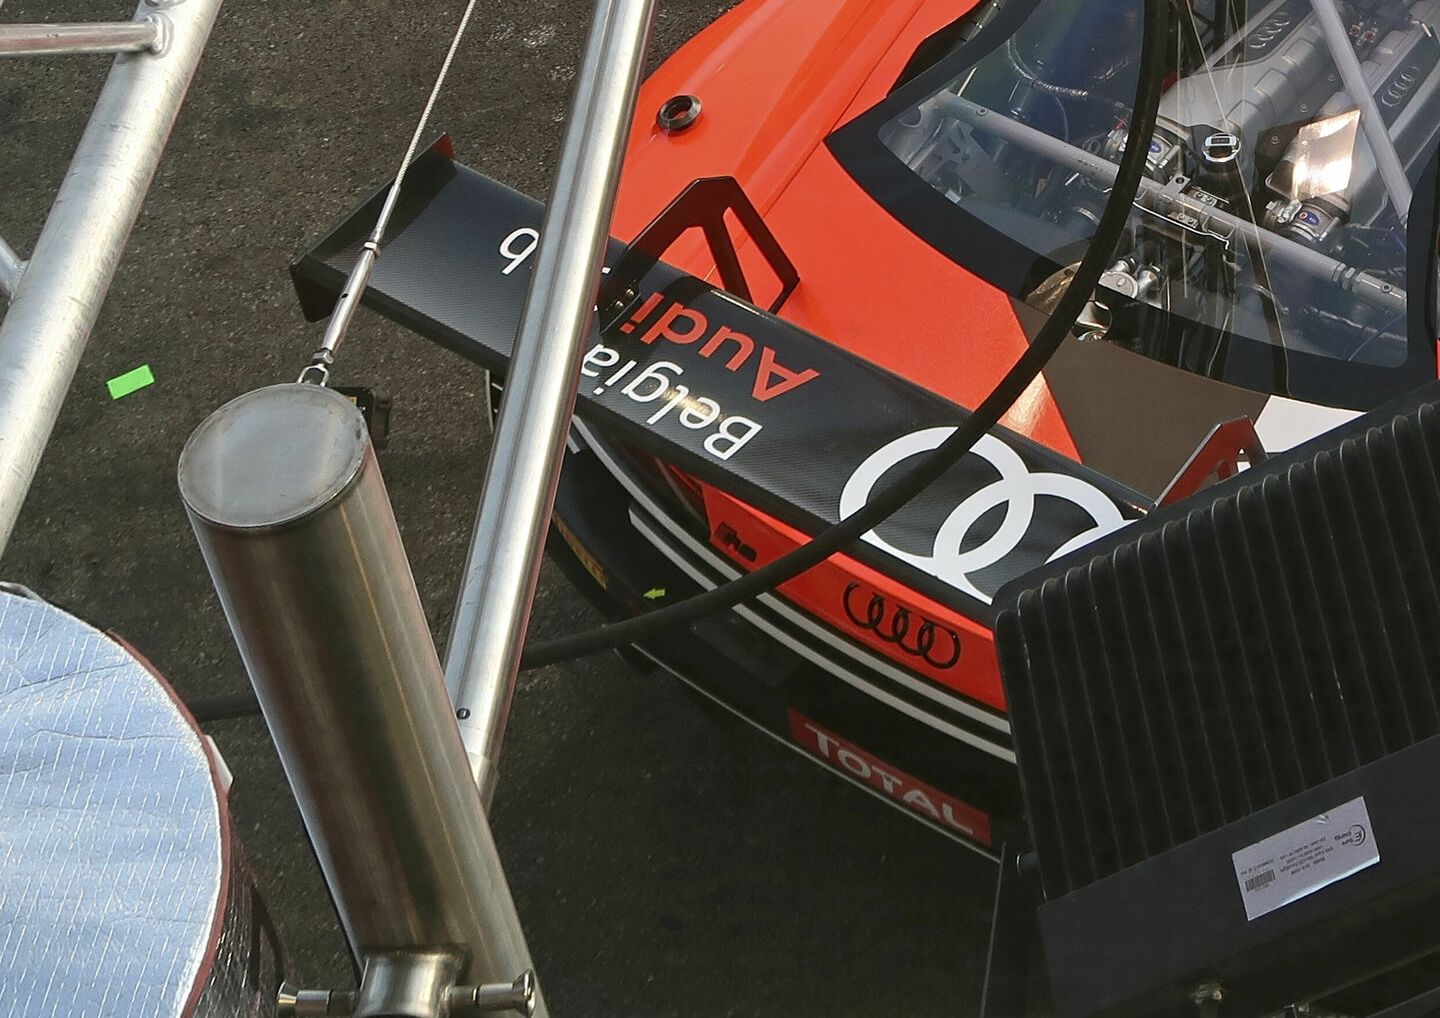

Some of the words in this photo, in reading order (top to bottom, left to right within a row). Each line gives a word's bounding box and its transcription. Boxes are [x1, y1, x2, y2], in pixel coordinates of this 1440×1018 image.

[579, 343, 763, 461] Belgia
[619, 291, 821, 402] Audi
[805, 723, 973, 835] TOTAL
